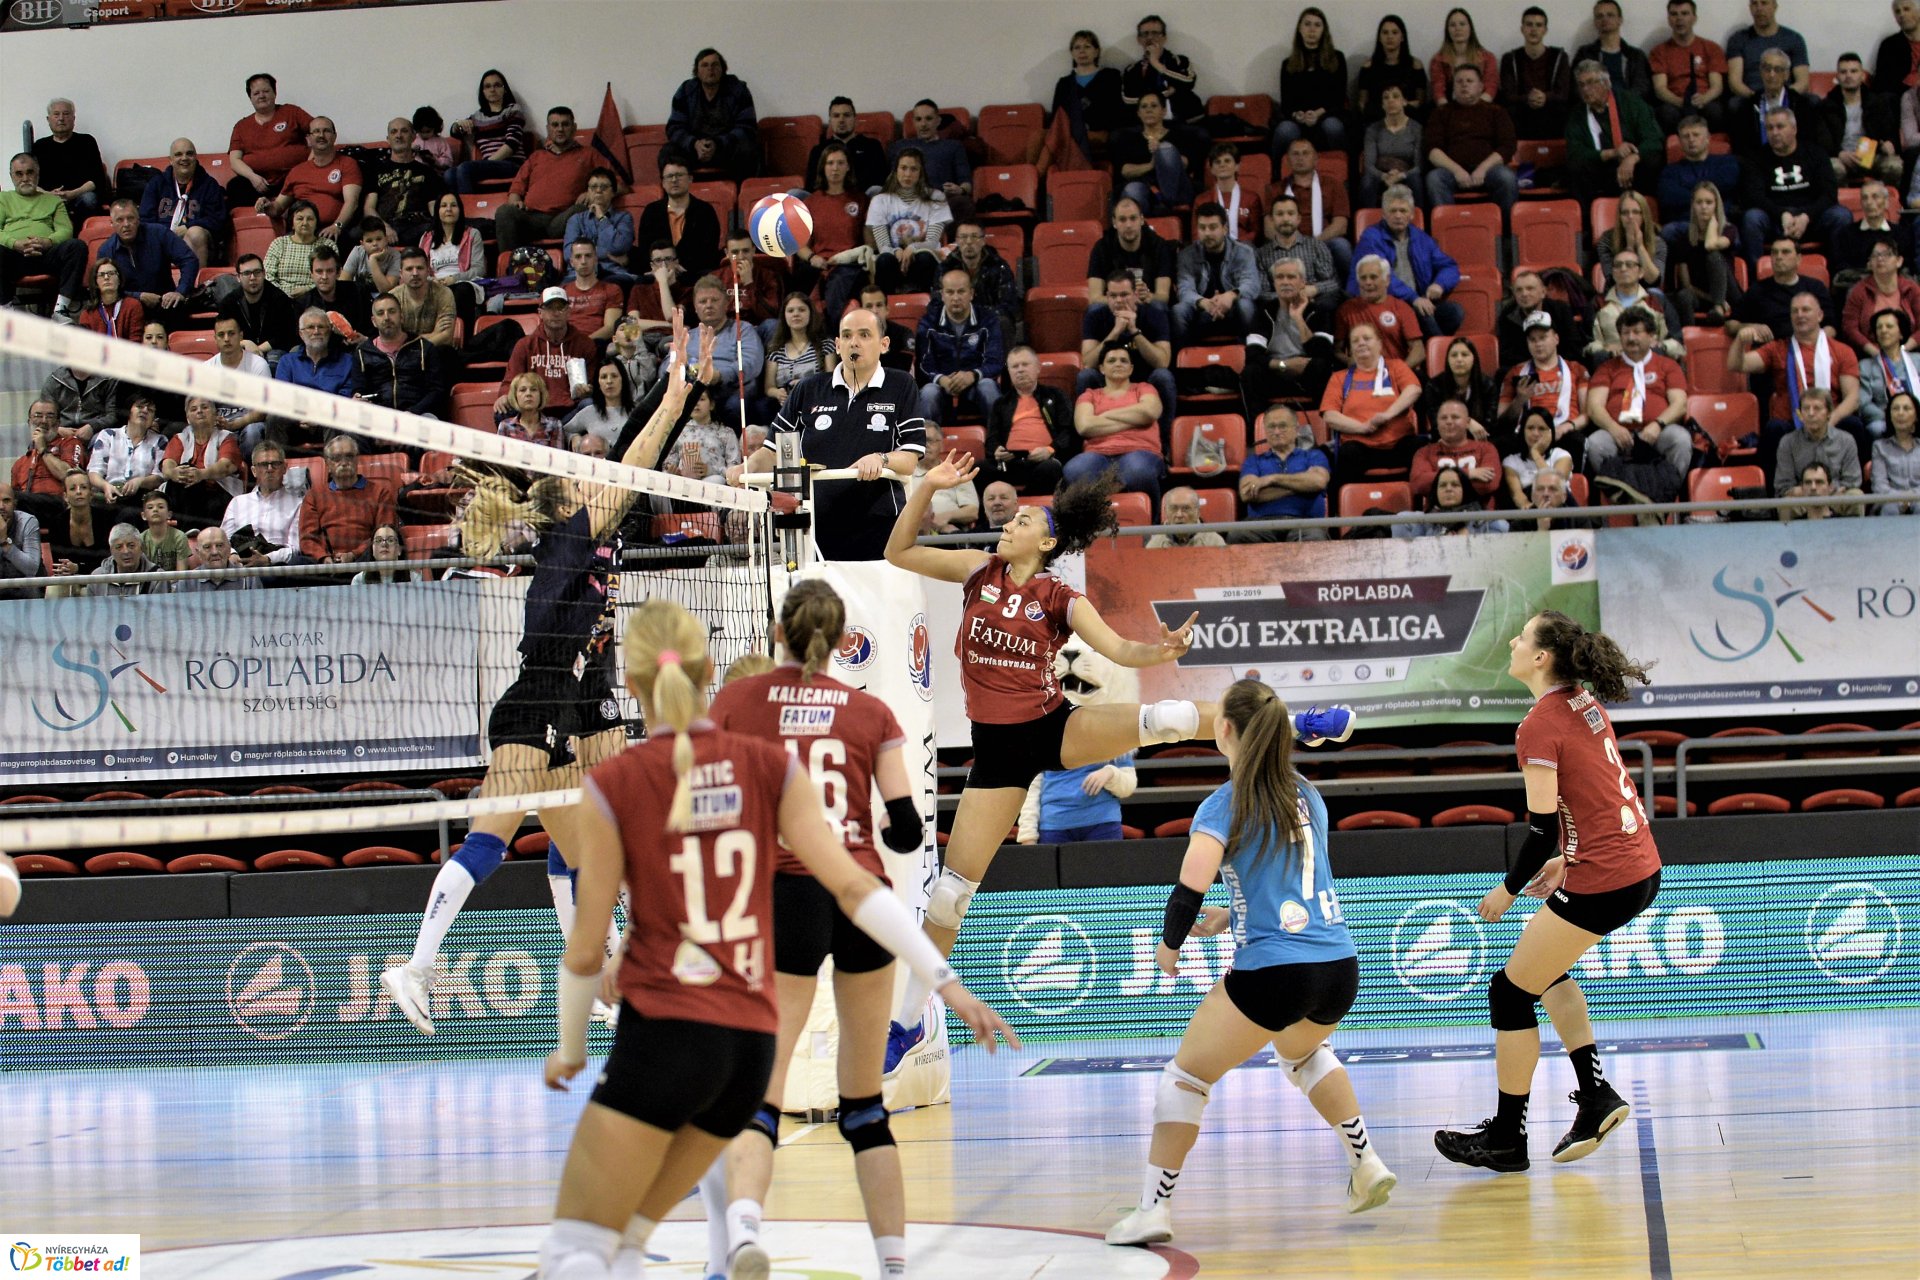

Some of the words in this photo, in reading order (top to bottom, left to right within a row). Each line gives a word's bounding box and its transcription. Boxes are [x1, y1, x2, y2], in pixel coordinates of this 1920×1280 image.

[20, 0, 53, 20] BH
[83, 5, 130, 18] Csoport
[159, 197, 201, 219] GP
[1222, 588, 1262, 599] 2018-2019
[1317, 584, 1414, 602] RÖPLABDA
[1857, 578, 1920, 619] RÖ
[1002, 593, 1023, 618] 3
[250, 631, 325, 649] MAGYAR
[966, 616, 1038, 656] FATUM
[1191, 616, 1251, 649] NŐI
[1258, 613, 1446, 647] EXTRALIGA
[185, 651, 397, 690] RÖPLABDA
[243, 692, 338, 713] SZÖVETSÉG
[767, 685, 849, 706] KALICANIN
[1655, 689, 1761, 702] magyarroplabdaszovetseg
[1783, 686, 1823, 697] hunvolley
[1851, 683, 1892, 695] Hunvolley
[1354, 704, 1383, 713] magyar
[1384, 700, 1420, 710] röplabda
[1421, 697, 1462, 709] szövetség
[1483, 695, 1537, 706] www.hunvolle
[782, 708, 832, 725] FATUM
[117, 755, 154, 766] hunvolley
[180, 753, 218, 764] Hunvolley
[244, 750, 273, 761] magyar
[273, 748, 308, 759] röplabda
[308, 747, 347, 759] szövetség
[367, 744, 436, 755] www.hunvolley.hu
[689, 759, 735, 788] ATIC
[1603, 737, 1636, 800] 2
[784, 738, 849, 823] 6
[690, 792, 737, 815] ATUM
[669, 829, 759, 945] 12
